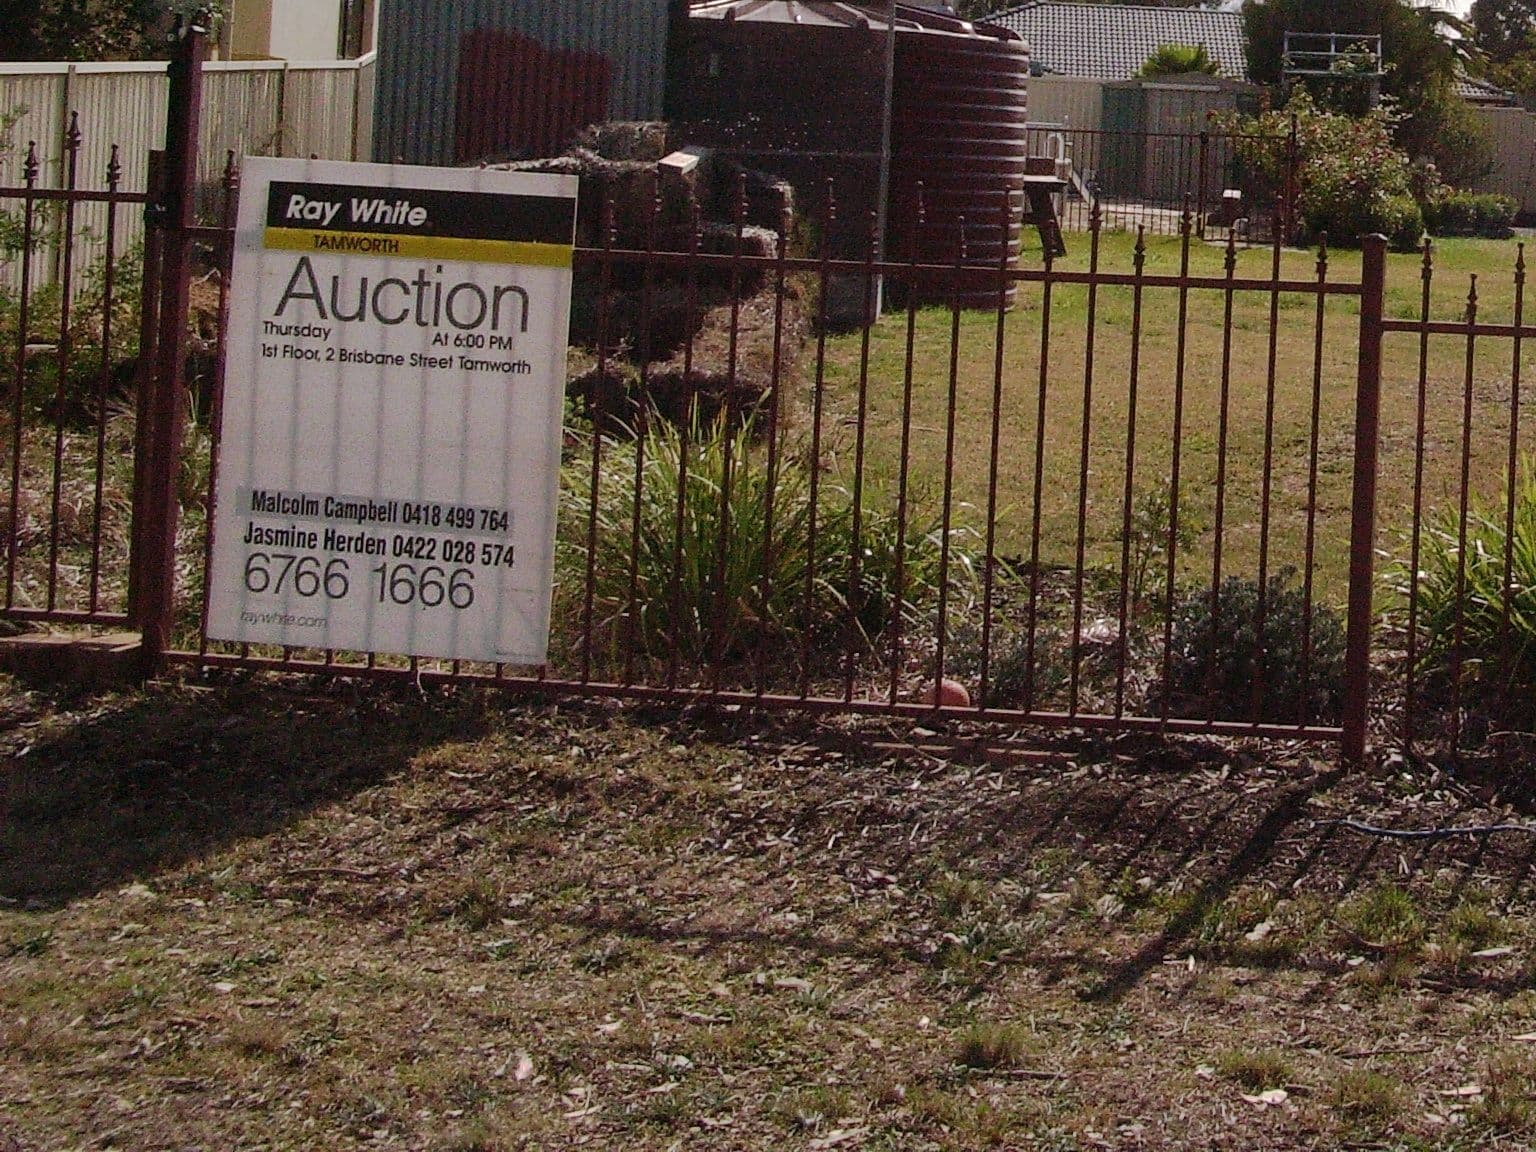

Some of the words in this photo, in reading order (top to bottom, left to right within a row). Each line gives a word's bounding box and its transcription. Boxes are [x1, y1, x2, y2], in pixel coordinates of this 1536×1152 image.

[286, 194, 341, 226] Ray
[351, 198, 428, 226] White
[313, 235, 399, 254] TAMWORTH
[273, 255, 530, 333] Auction
[263, 321, 332, 341] Thursday
[432, 334, 448, 347] At
[453, 334, 485, 349] 6:00
[489, 336, 513, 351] PM
[261, 343, 278, 358] 1st
[282, 345, 321, 362] Floor,
[325, 348, 335, 361] 2
[339, 349, 405, 366] Brisbane
[409, 352, 454, 370] Street
[458, 355, 532, 375] Tamworth
[251, 490, 320, 516] Malcolm
[324, 496, 398, 525] Campbell
[402, 502, 441, 527] 0418
[445, 507, 475, 529] 499
[480, 509, 509, 532] 764
[244, 521, 318, 549] Jasmine
[323, 528, 387, 556] Herden
[393, 534, 437, 560] 0422
[442, 539, 476, 565] 028
[481, 542, 515, 568] 574
[244, 551, 350, 600] 6766
[372, 561, 475, 609] 1666
